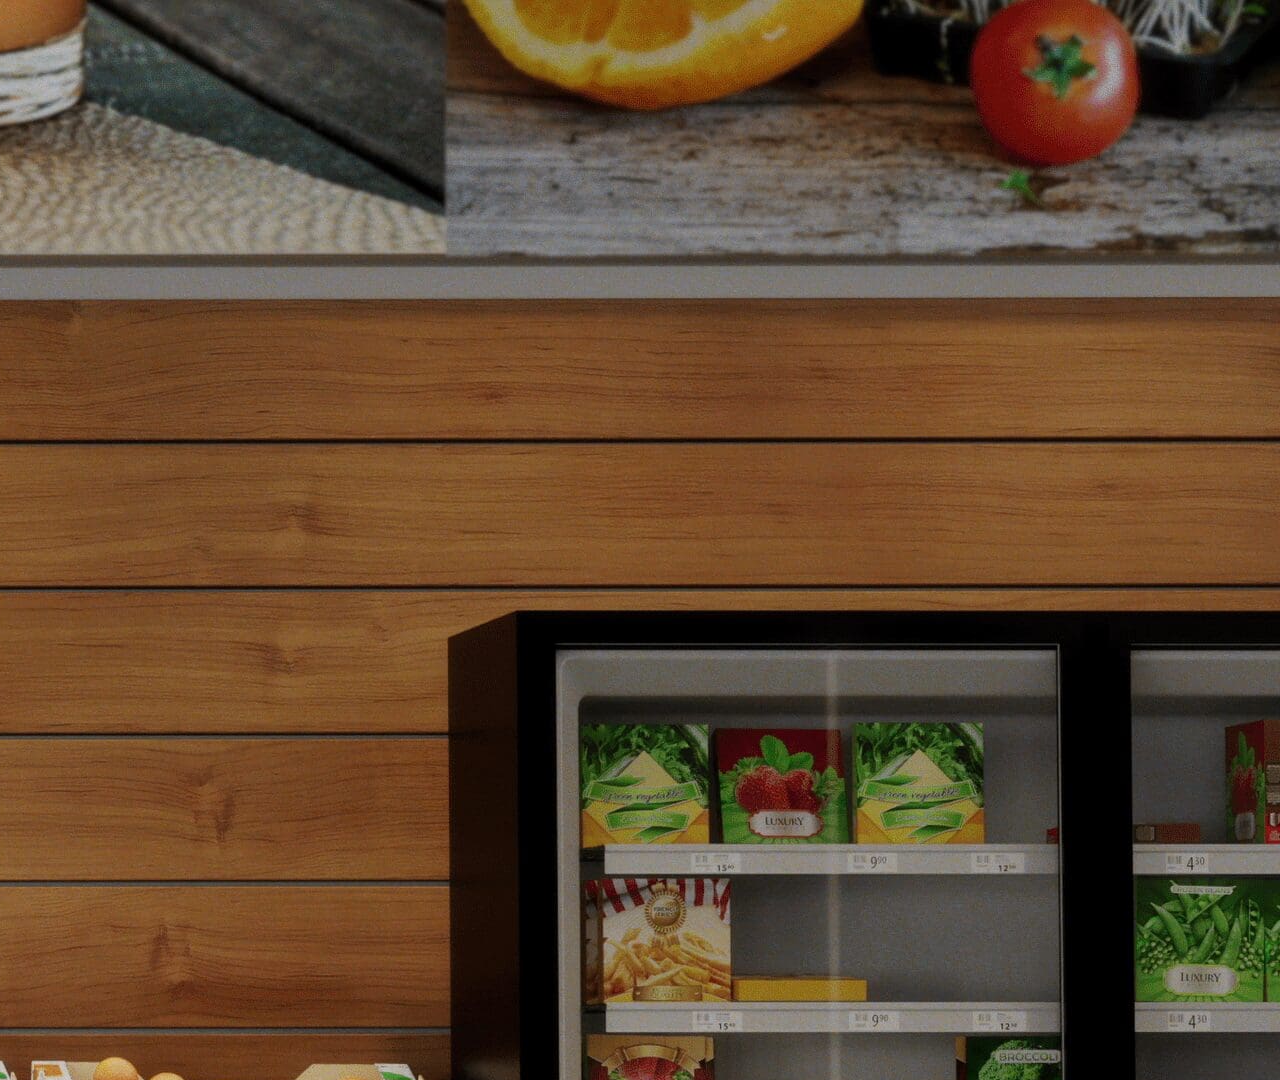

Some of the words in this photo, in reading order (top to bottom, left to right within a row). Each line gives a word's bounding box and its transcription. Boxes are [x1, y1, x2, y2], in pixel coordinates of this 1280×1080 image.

[765, 816, 804, 825] LUXURY
[1180, 972, 1221, 983] LUXURY
[999, 1053, 1059, 1062] BROCCOLI
